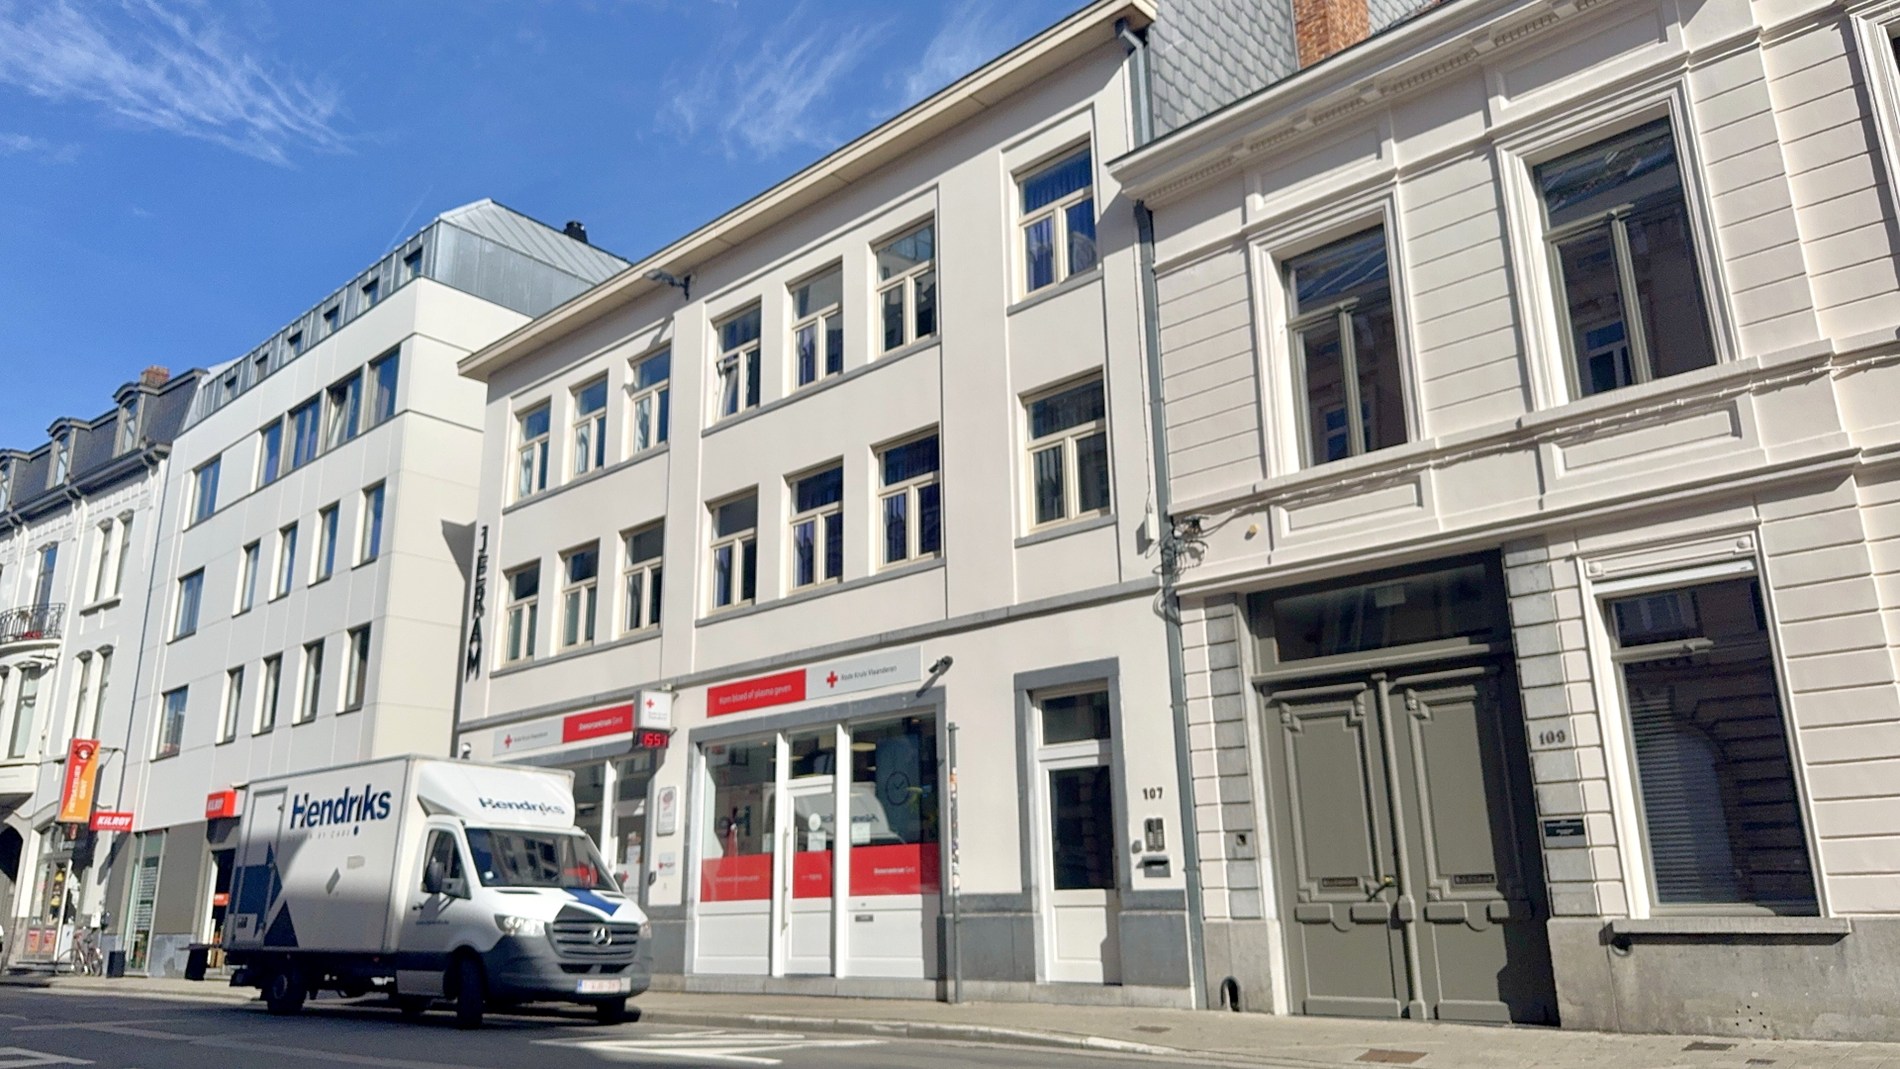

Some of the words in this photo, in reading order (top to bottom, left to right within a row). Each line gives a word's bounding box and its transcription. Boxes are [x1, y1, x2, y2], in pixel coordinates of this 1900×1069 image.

[1539, 730, 1566, 745] 109
[1142, 786, 1163, 800] 107
[290, 783, 392, 836] Hendriks
[479, 797, 565, 816] Hendriks
